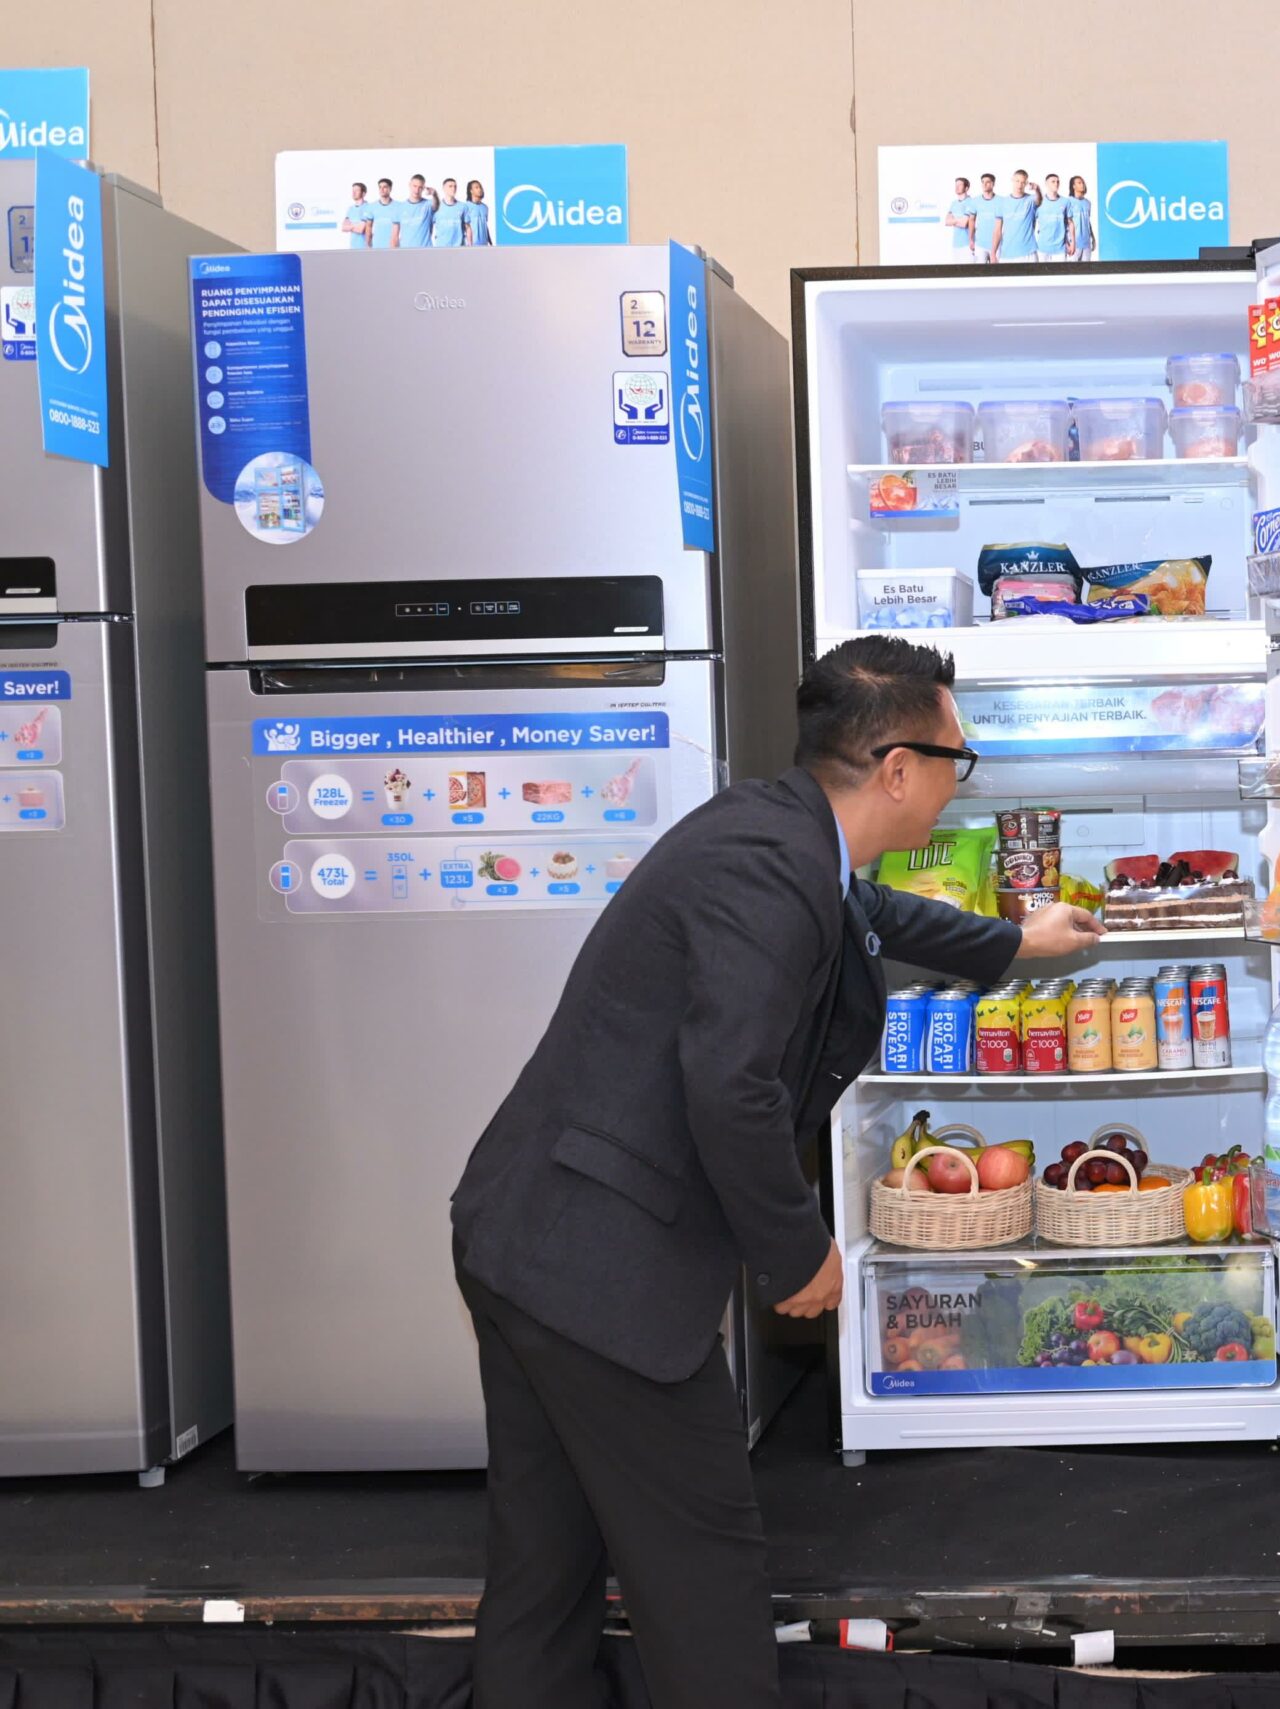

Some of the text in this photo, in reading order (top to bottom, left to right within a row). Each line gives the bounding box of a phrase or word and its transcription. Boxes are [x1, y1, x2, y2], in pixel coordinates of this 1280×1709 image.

[0, 109, 84, 149] Midea
[502, 184, 622, 234] Midea
[1105, 180, 1224, 229] Midea
[49, 195, 93, 375] Midea
[201, 285, 301, 298] RUANG PENYIMPANAN
[202, 295, 295, 308] DAPAT DISESUAIKAN
[630, 299, 638, 310] 2
[202, 305, 301, 318] PENDINGINAN EFISIEN
[633, 320, 656, 338] 12
[680, 285, 704, 462] Midea
[1000, 561, 1066, 574] KANZLER
[1087, 563, 1141, 579] KANZLER
[883, 584, 924, 594] Es Batu
[874, 595, 938, 605] Lebih Besar
[4, 681, 60, 696] Saver!
[973, 709, 1147, 725] UNTUK PENYAJIAN TERBAIK.
[310, 729, 380, 751] Bigger
[399, 727, 494, 746] Healthier
[512, 726, 582, 748] Money
[589, 725, 657, 743] Saver!
[317, 788, 345, 798] 128L
[313, 798, 348, 806] Freezer
[387, 853, 414, 862] 350L
[317, 868, 348, 878] 473L
[445, 875, 470, 884] 123L
[322, 878, 345, 886] Total
[888, 1012, 897, 1063] SWEAT
[897, 1012, 907, 1069] POCARI
[934, 1012, 943, 1064] SWEAT
[943, 1012, 954, 1069] POCARI
[886, 1293, 982, 1310] SAYURAN
[886, 1313, 962, 1330] & BUAH
[883, 1375, 915, 1390] Midea
